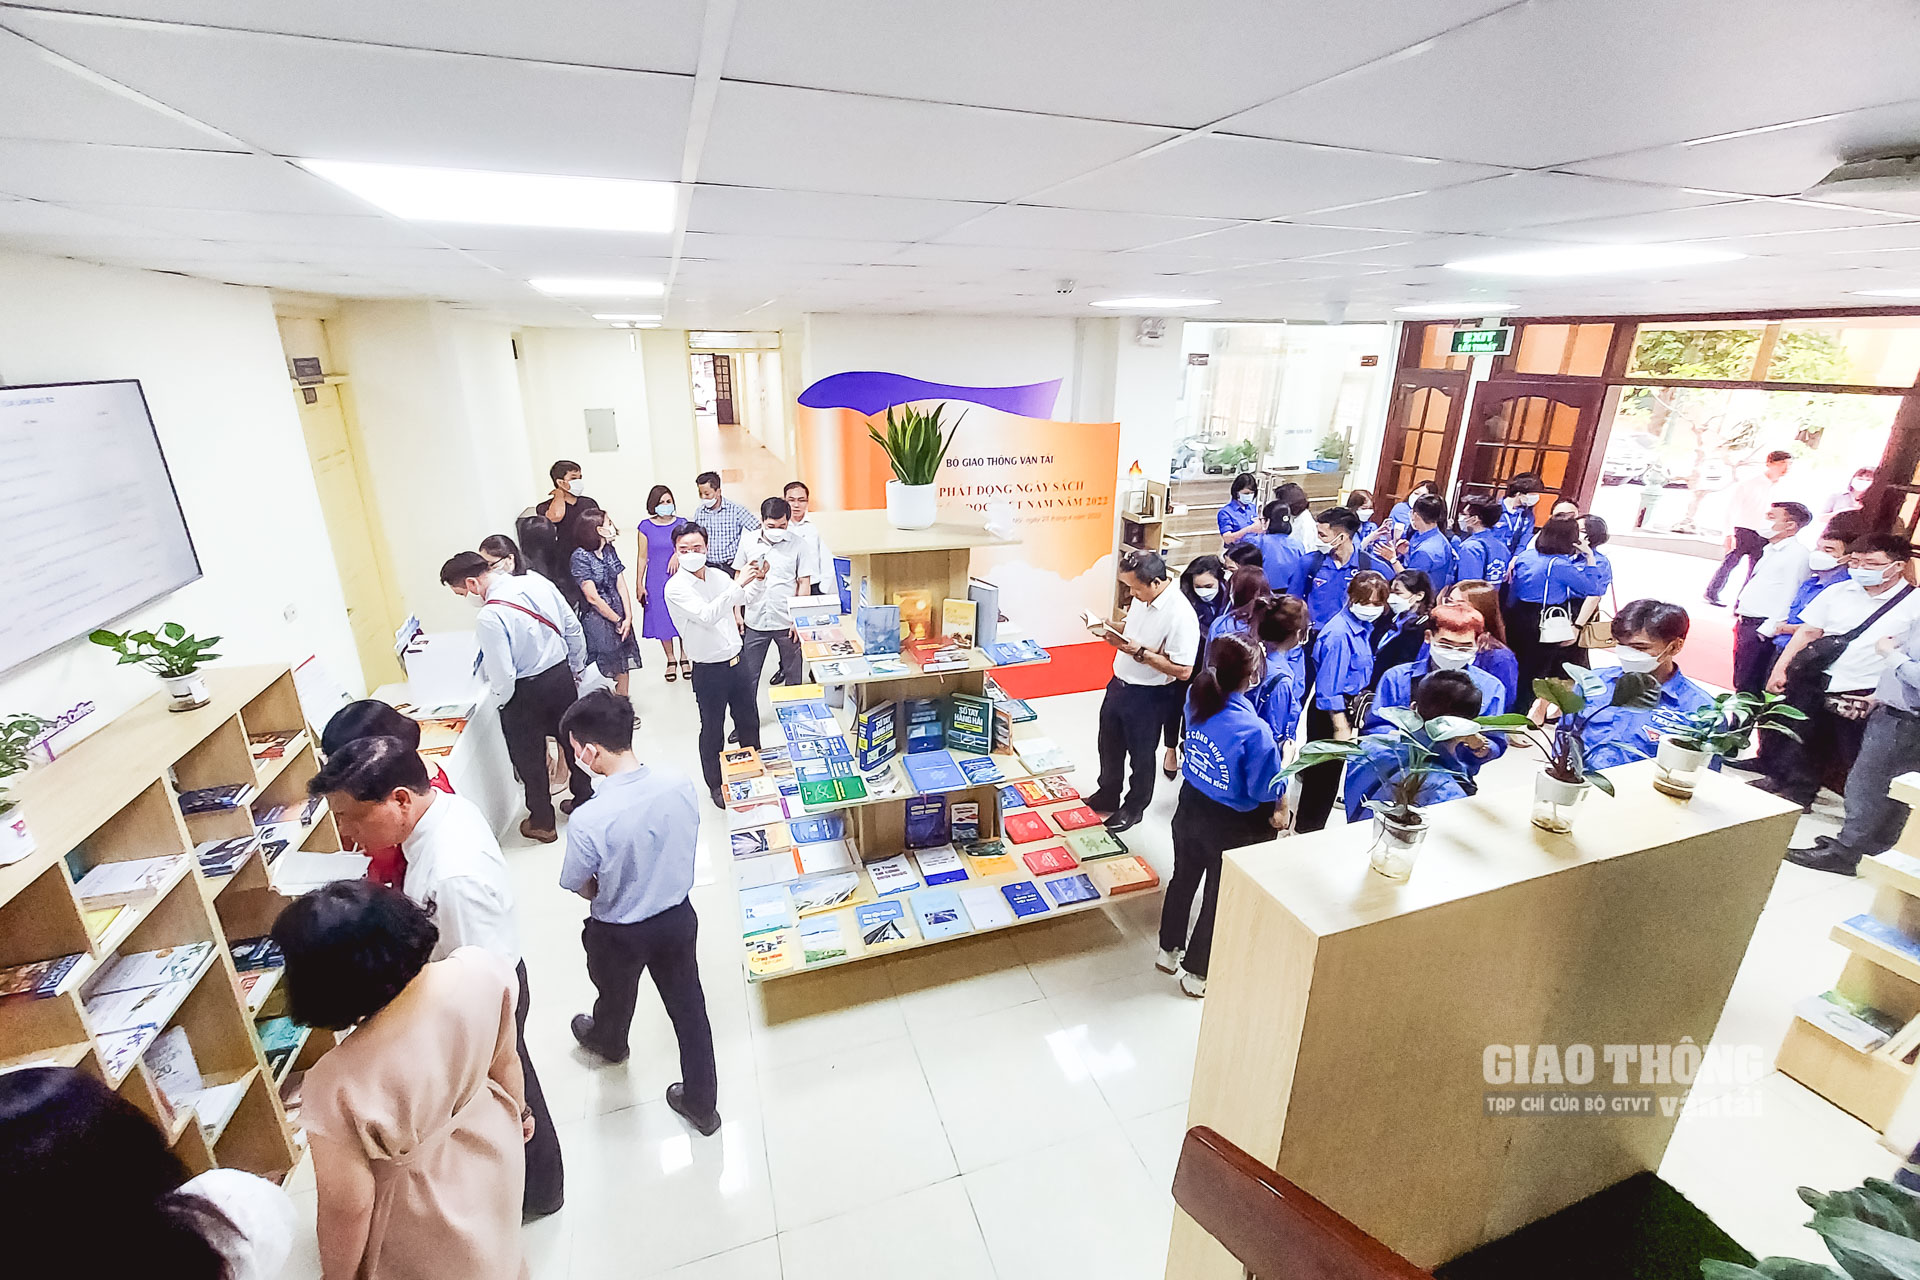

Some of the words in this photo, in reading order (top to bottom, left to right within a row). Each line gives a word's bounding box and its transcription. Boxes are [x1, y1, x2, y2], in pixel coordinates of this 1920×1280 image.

[1463, 331, 1497, 342] EXIT
[946, 456, 959, 469] BỘ
[962, 457, 984, 467] GIAO
[986, 454, 1017, 466] THÔNG
[1019, 456, 1038, 467] VẬN
[939, 483, 971, 497] PHÁT
[1016, 480, 1049, 493] NGÀY
[1053, 479, 1085, 492] SÁCH
[1027, 499, 1053, 509] NAM
[1057, 496, 1082, 507] NĂM
[1086, 496, 1108, 506] 2022
[1191, 730, 1209, 744] CÔNG
[1219, 764, 1230, 784] GTVT
